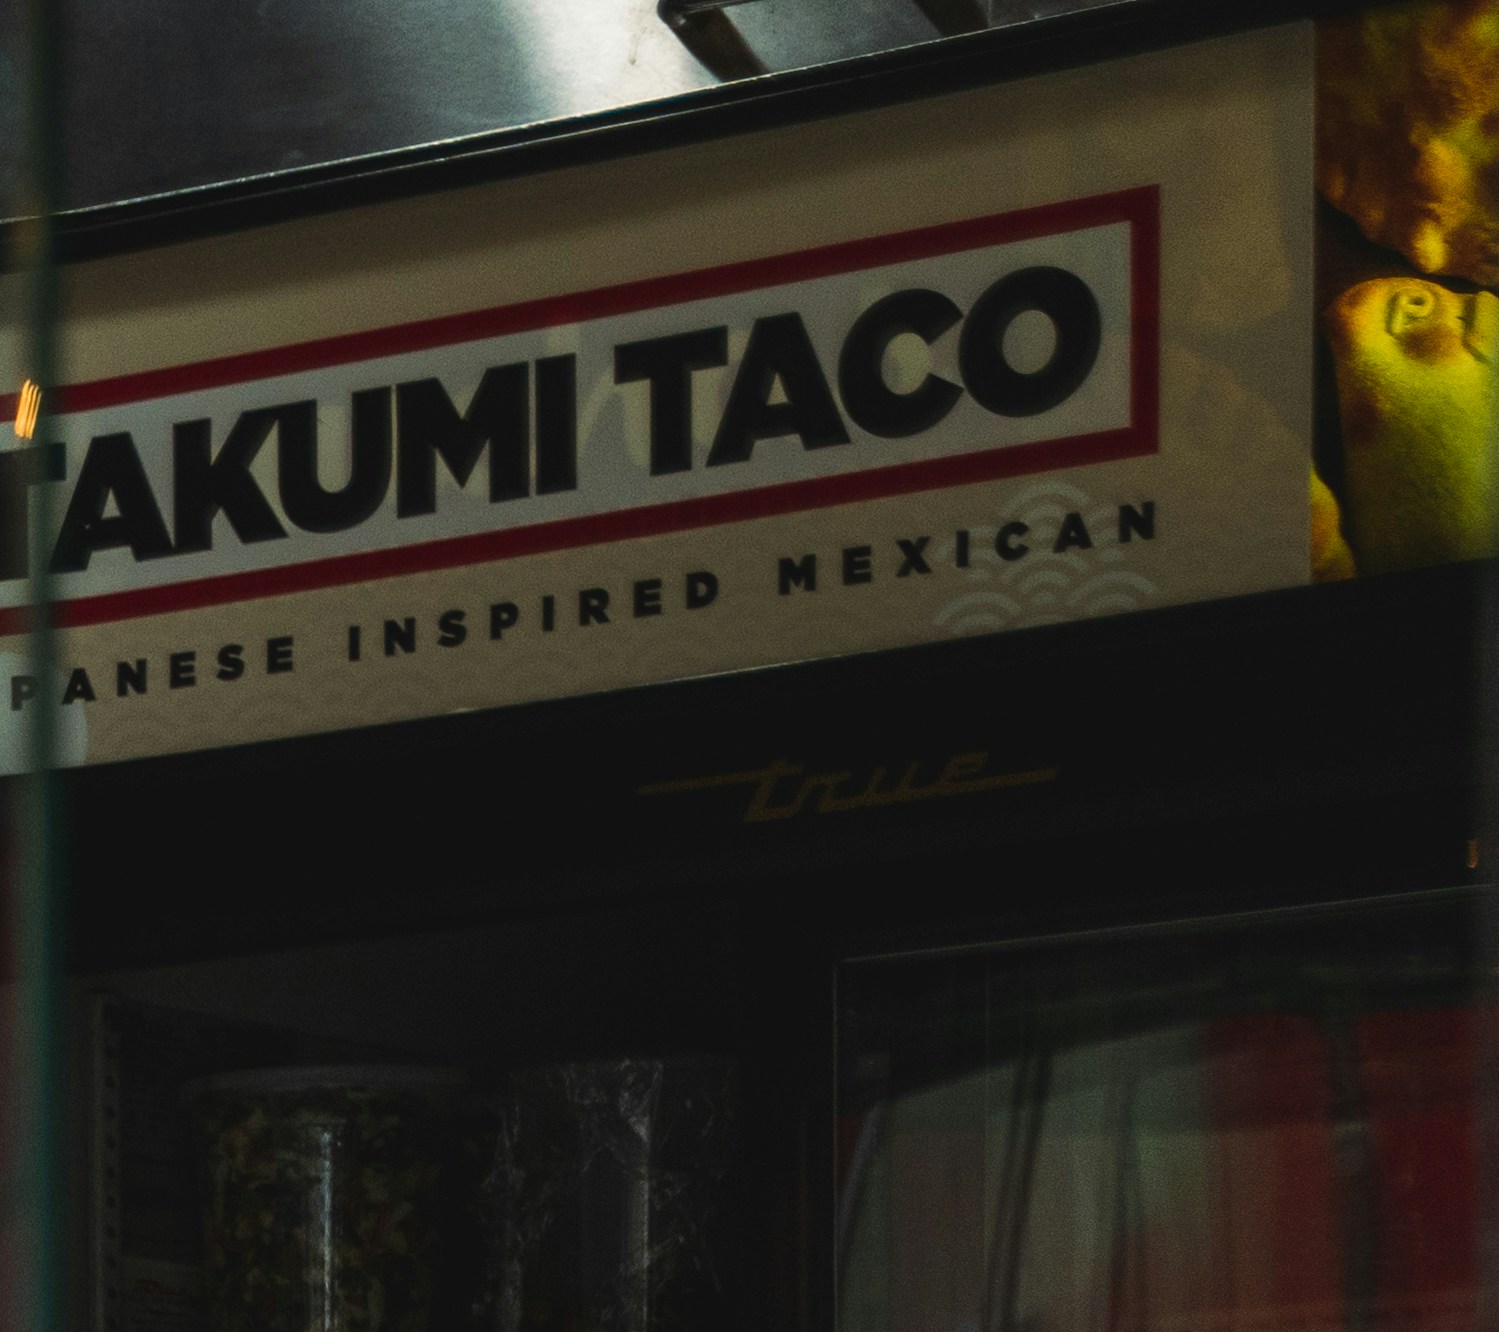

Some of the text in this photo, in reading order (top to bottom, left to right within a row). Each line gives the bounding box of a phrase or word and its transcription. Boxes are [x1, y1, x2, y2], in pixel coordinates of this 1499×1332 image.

[613, 264, 1102, 477] TACO
[347, 570, 720, 662] INSPIRED
[777, 500, 1156, 596] MEXICAN
